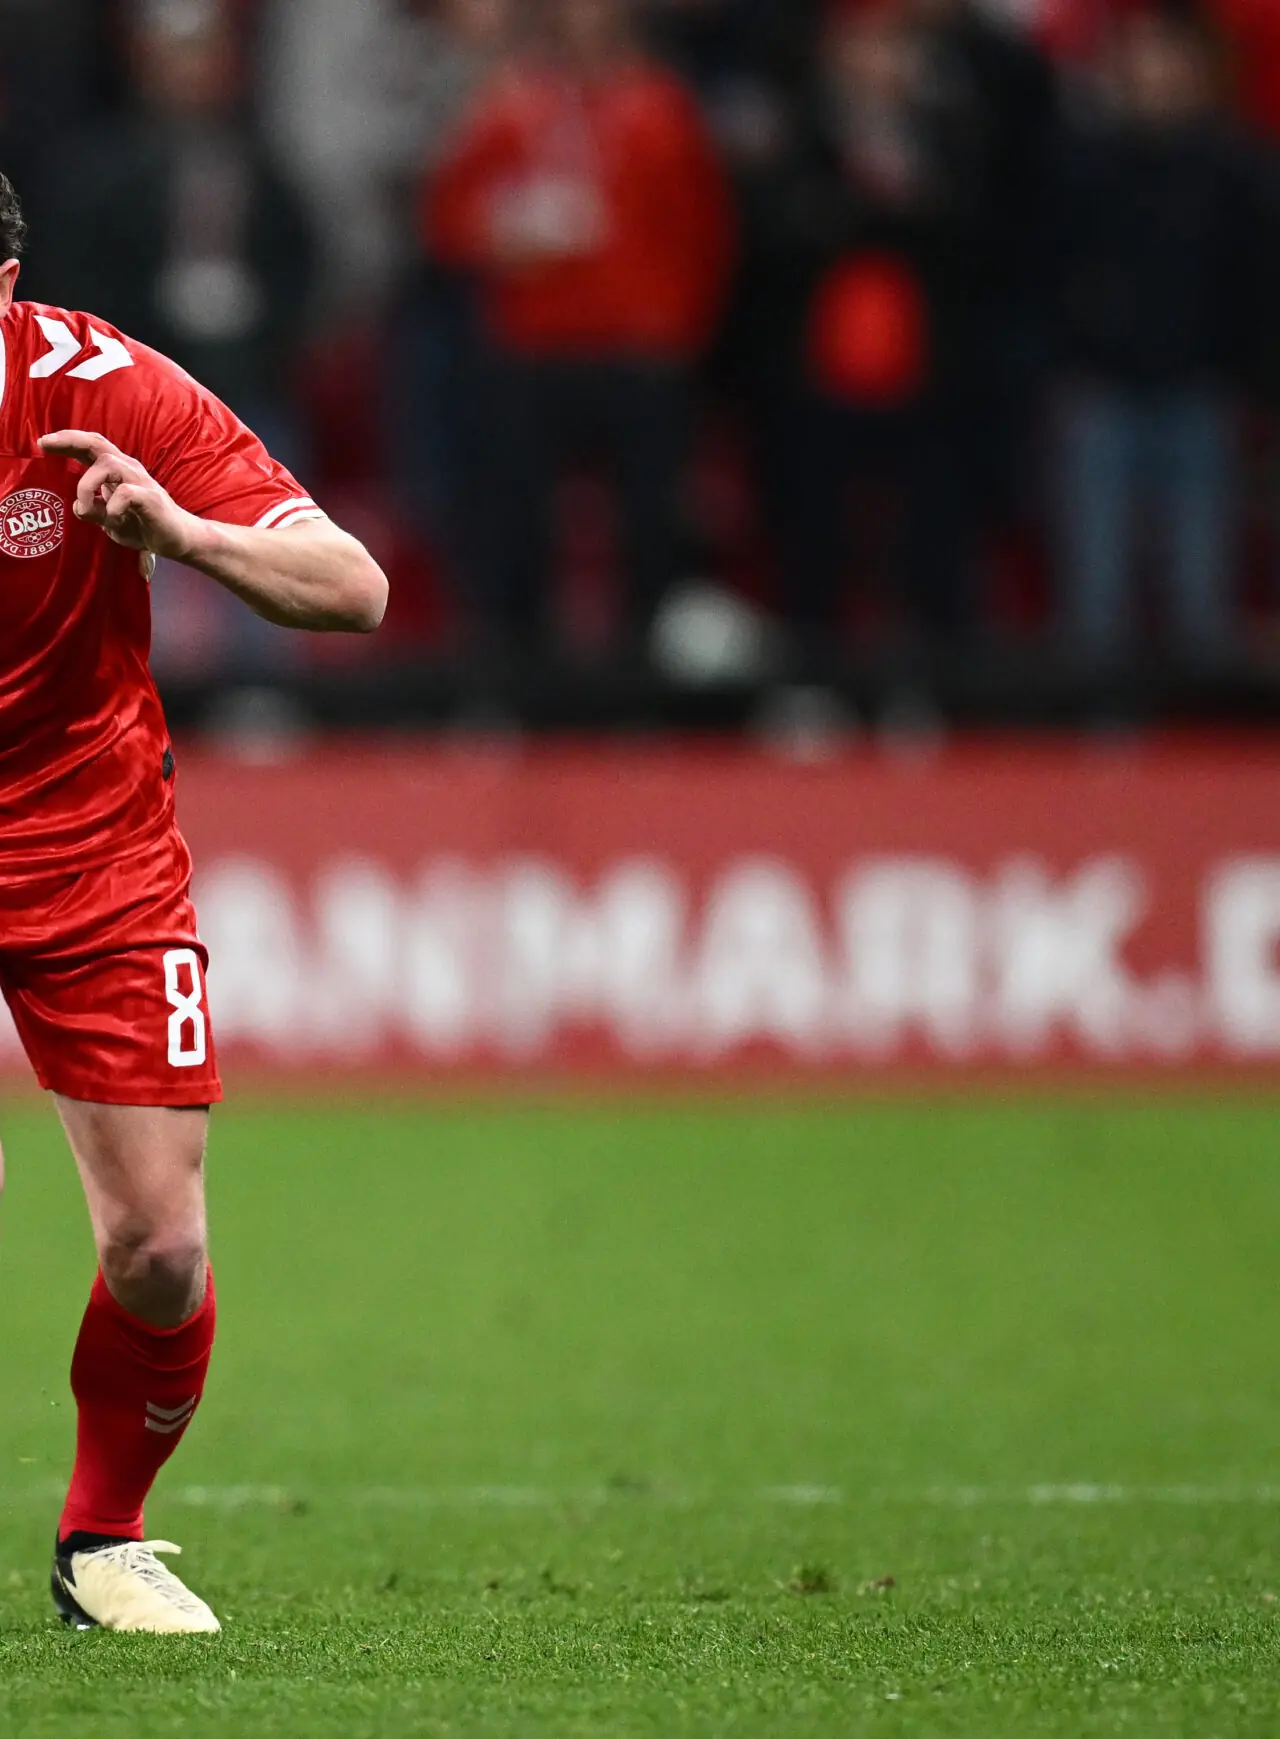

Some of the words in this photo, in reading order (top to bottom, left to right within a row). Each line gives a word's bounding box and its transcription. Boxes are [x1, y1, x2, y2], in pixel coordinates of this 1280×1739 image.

[6, 507, 54, 537] DBU
[23, 541, 54, 555] 1889
[162, 948, 206, 1067] 8
